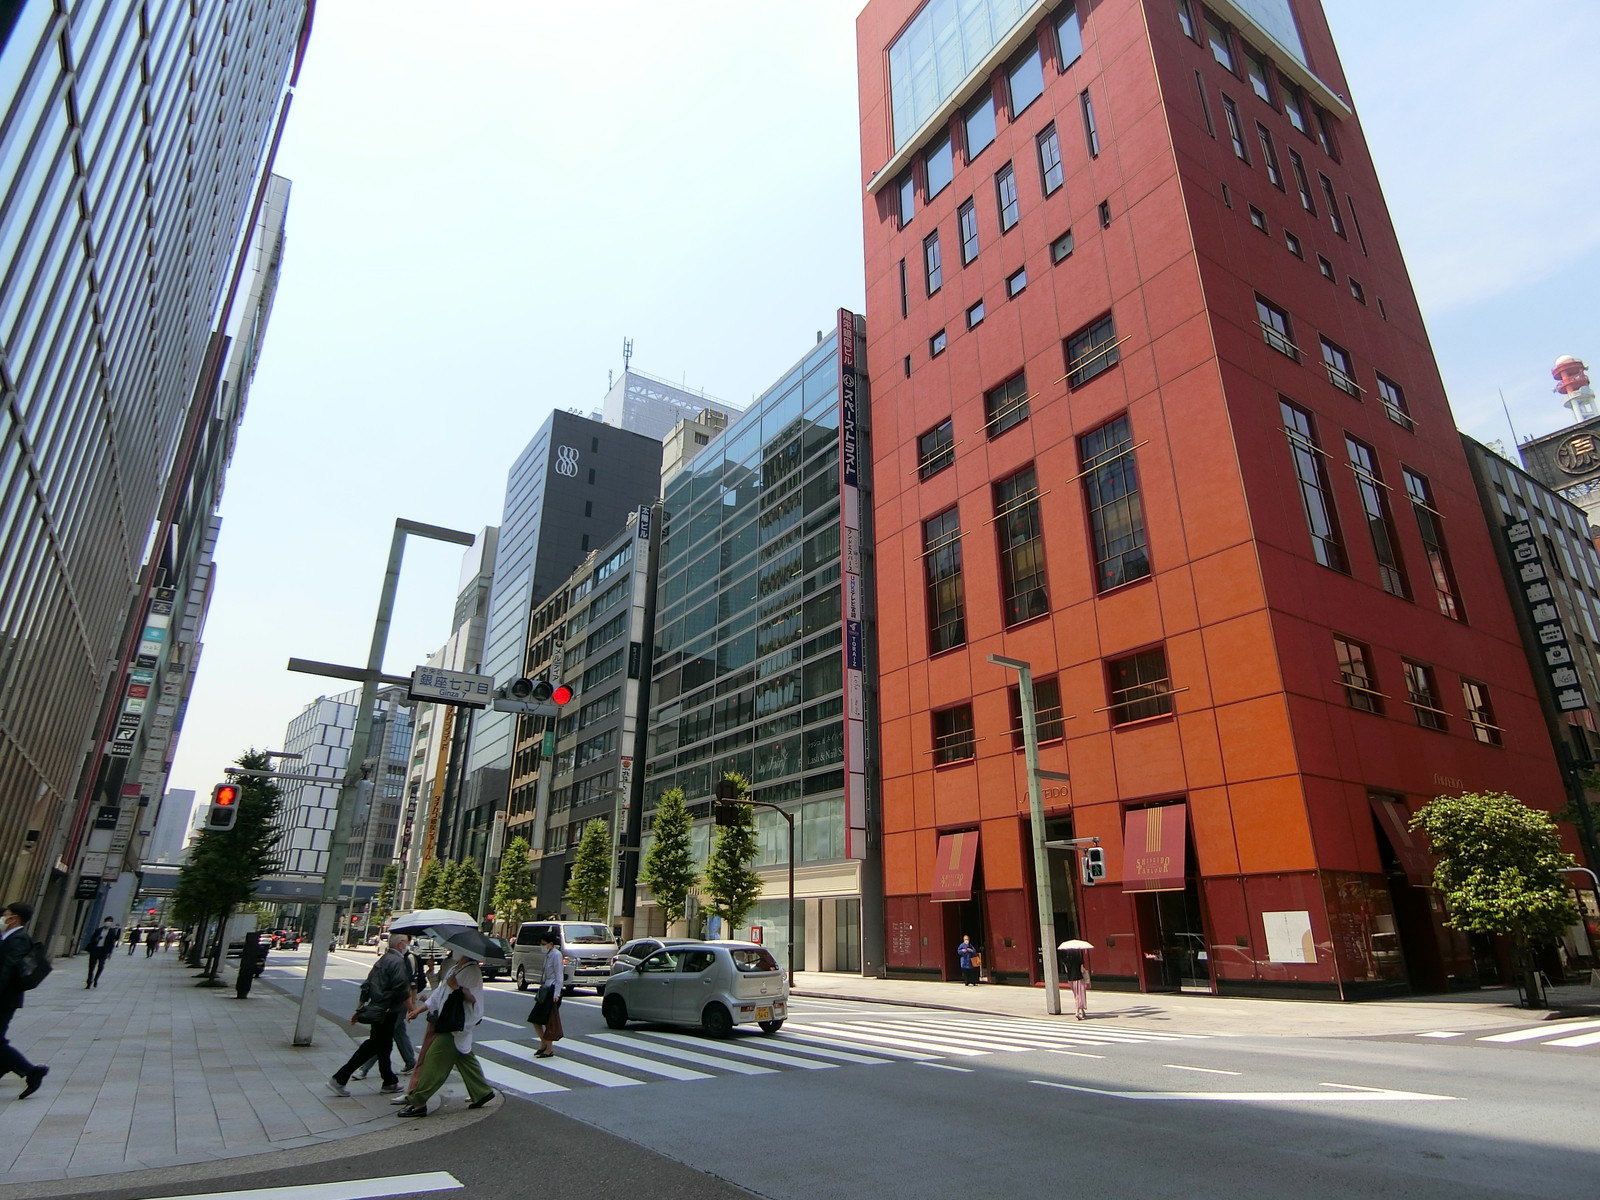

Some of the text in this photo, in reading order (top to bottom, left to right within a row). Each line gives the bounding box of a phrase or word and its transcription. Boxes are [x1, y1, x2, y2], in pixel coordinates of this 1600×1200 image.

[844, 389, 856, 475] スペーストラスト
[640, 506, 650, 538] 太陽ビル
[421, 667, 444, 675] 中央区
[419, 673, 489, 695] 銀座七丁目
[439, 688, 467, 699] Ginza 7
[1019, 785, 1069, 804] SEIDO
[1136, 856, 1170, 866] SHISEIDO
